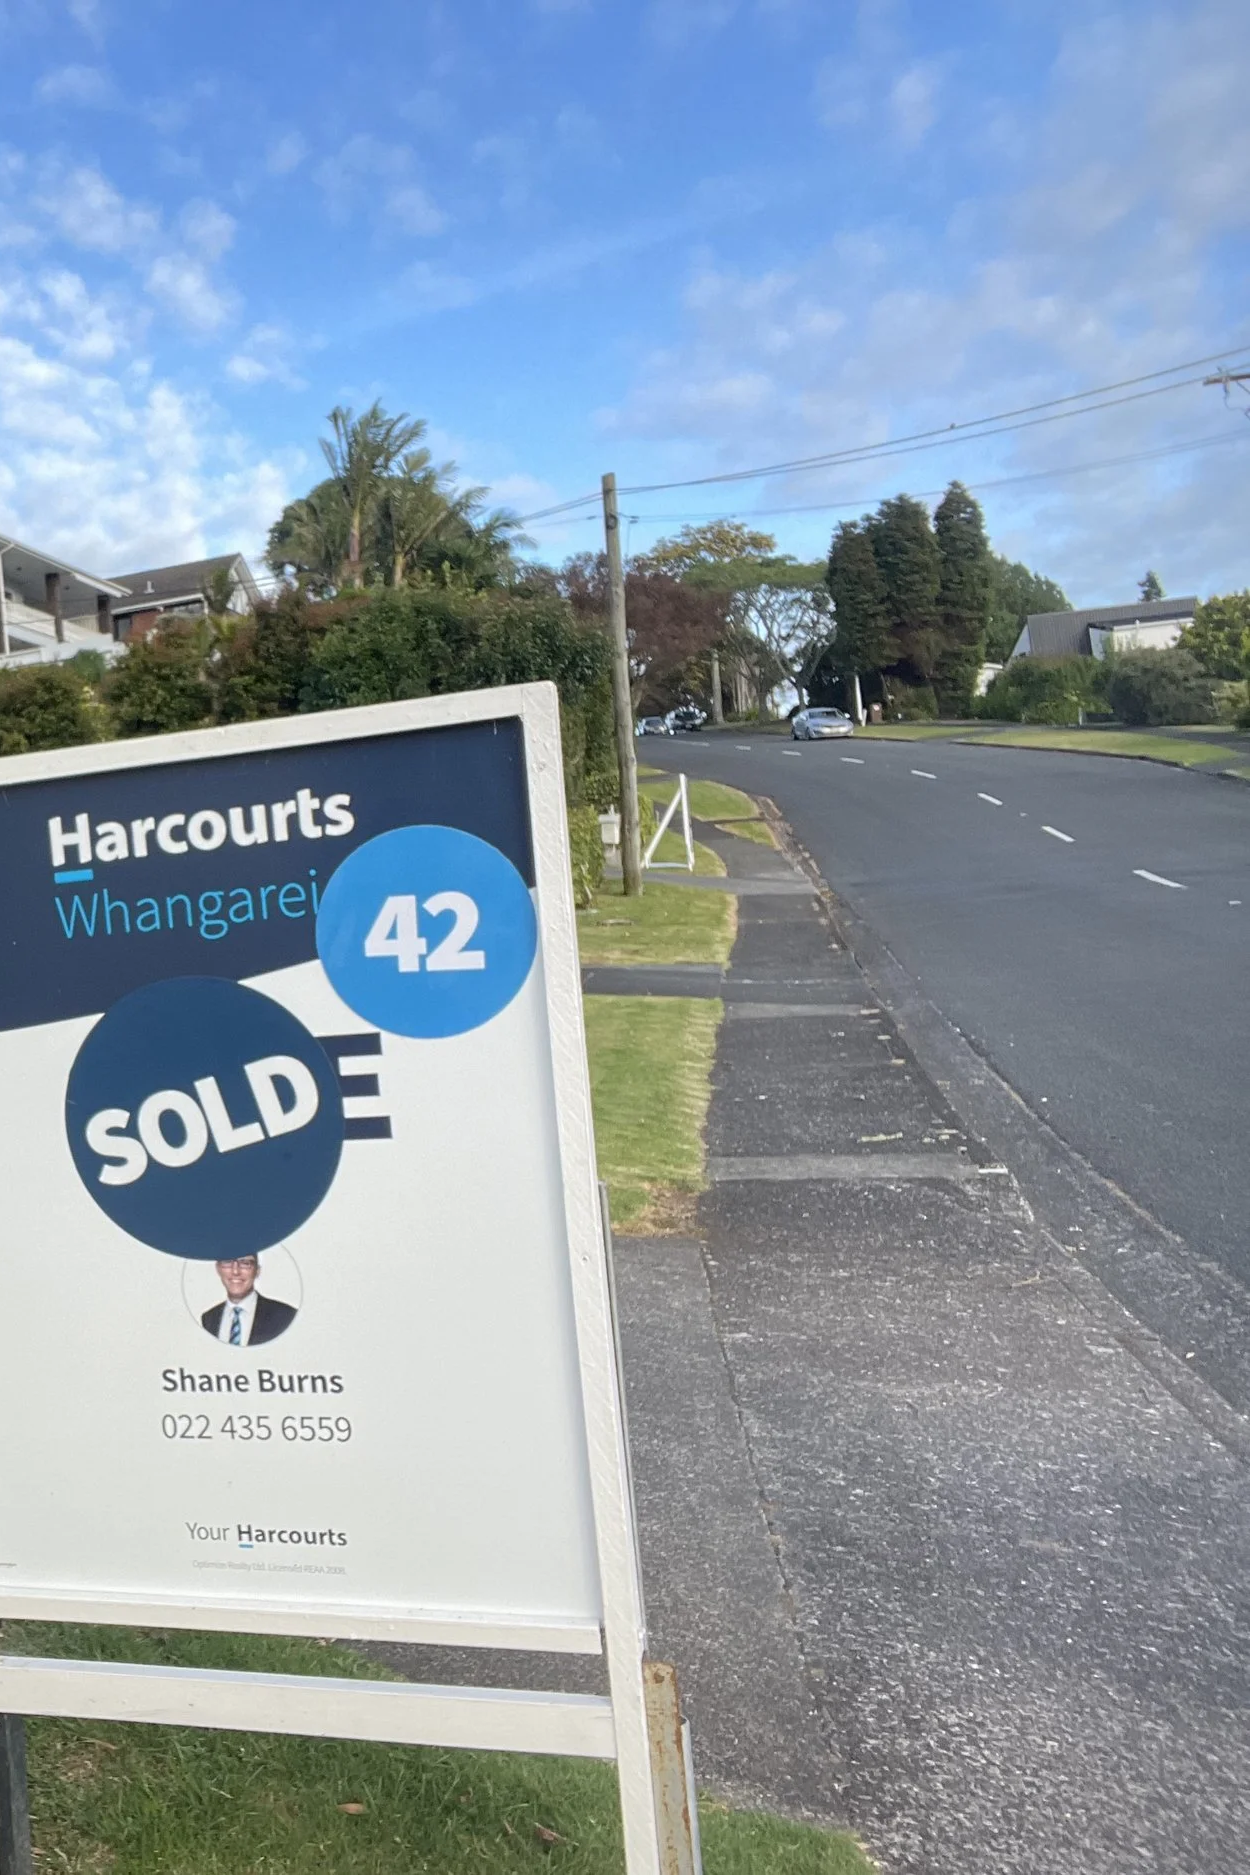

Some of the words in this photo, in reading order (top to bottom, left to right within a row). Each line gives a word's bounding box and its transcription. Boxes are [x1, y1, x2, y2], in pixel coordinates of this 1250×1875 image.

[48, 788, 355, 867] Harcourts
[55, 869, 320, 939] Whangarei
[364, 891, 486, 973] 42
[85, 1055, 320, 1186] SOLD
[162, 1367, 250, 1393] Shane
[257, 1369, 344, 1394] Burns
[162, 1414, 213, 1440] 022
[220, 1415, 272, 1441] 435
[281, 1415, 352, 1442] 6559
[185, 1522, 230, 1542] Your
[237, 1524, 348, 1546] Harcourts
